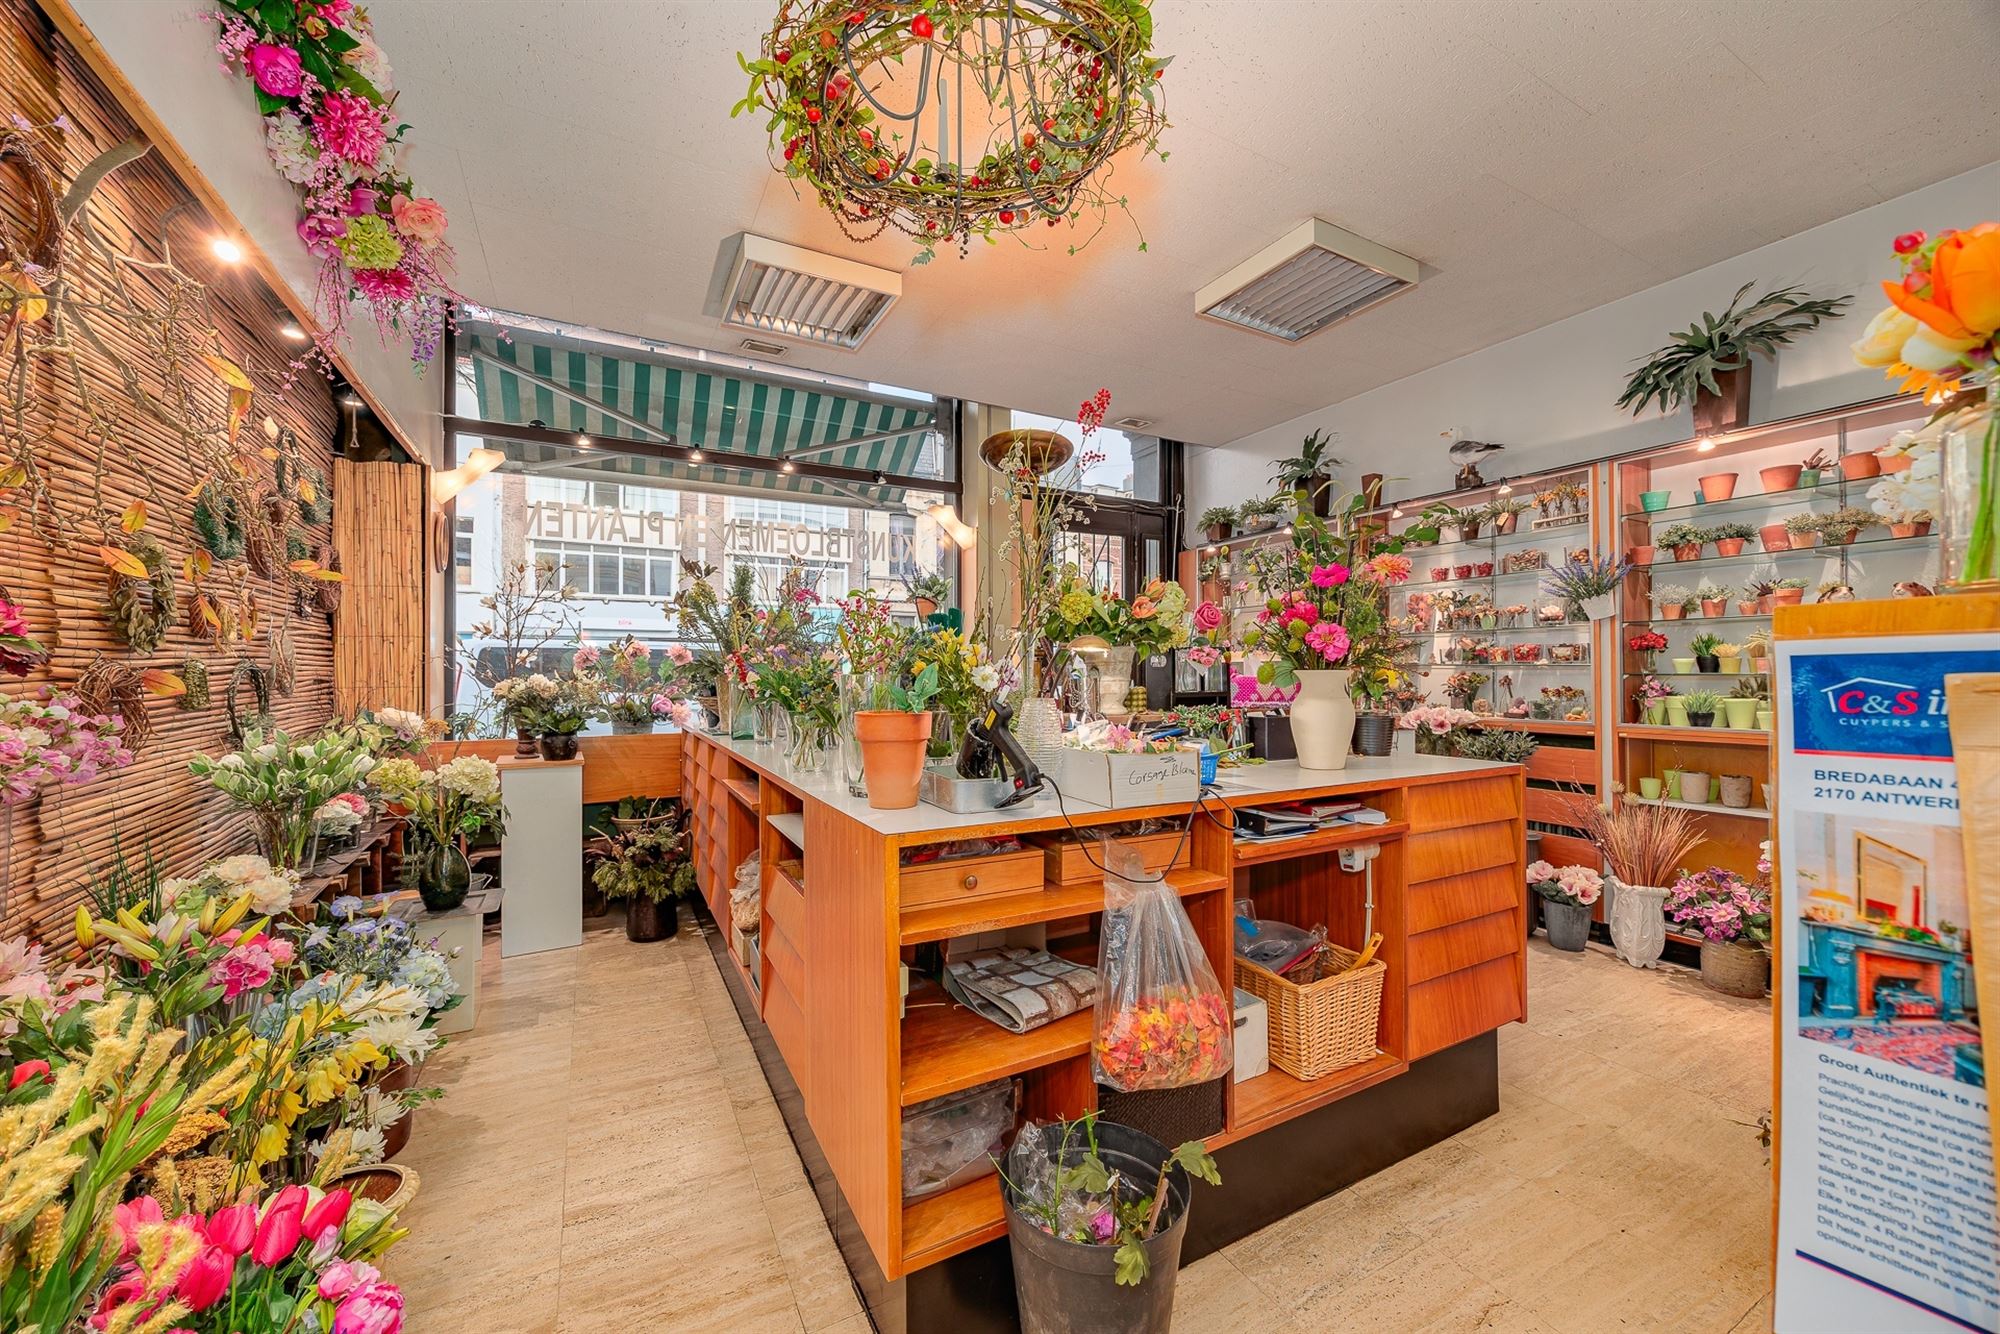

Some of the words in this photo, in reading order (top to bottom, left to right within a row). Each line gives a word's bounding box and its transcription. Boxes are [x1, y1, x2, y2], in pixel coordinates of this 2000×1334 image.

[1838, 690, 1919, 716] C&S
[1839, 717, 1911, 728] CUYPERS
[1919, 719, 1930, 728] &
[1814, 769, 1943, 789] BREDABAAN
[1813, 787, 1856, 801] 2170
[1819, 1053, 1859, 1072] Groot
[1864, 1066, 1948, 1099] Authentiek
[1955, 1093, 1969, 1105] te
[1818, 1085, 1884, 1113] Gelijkvloers
